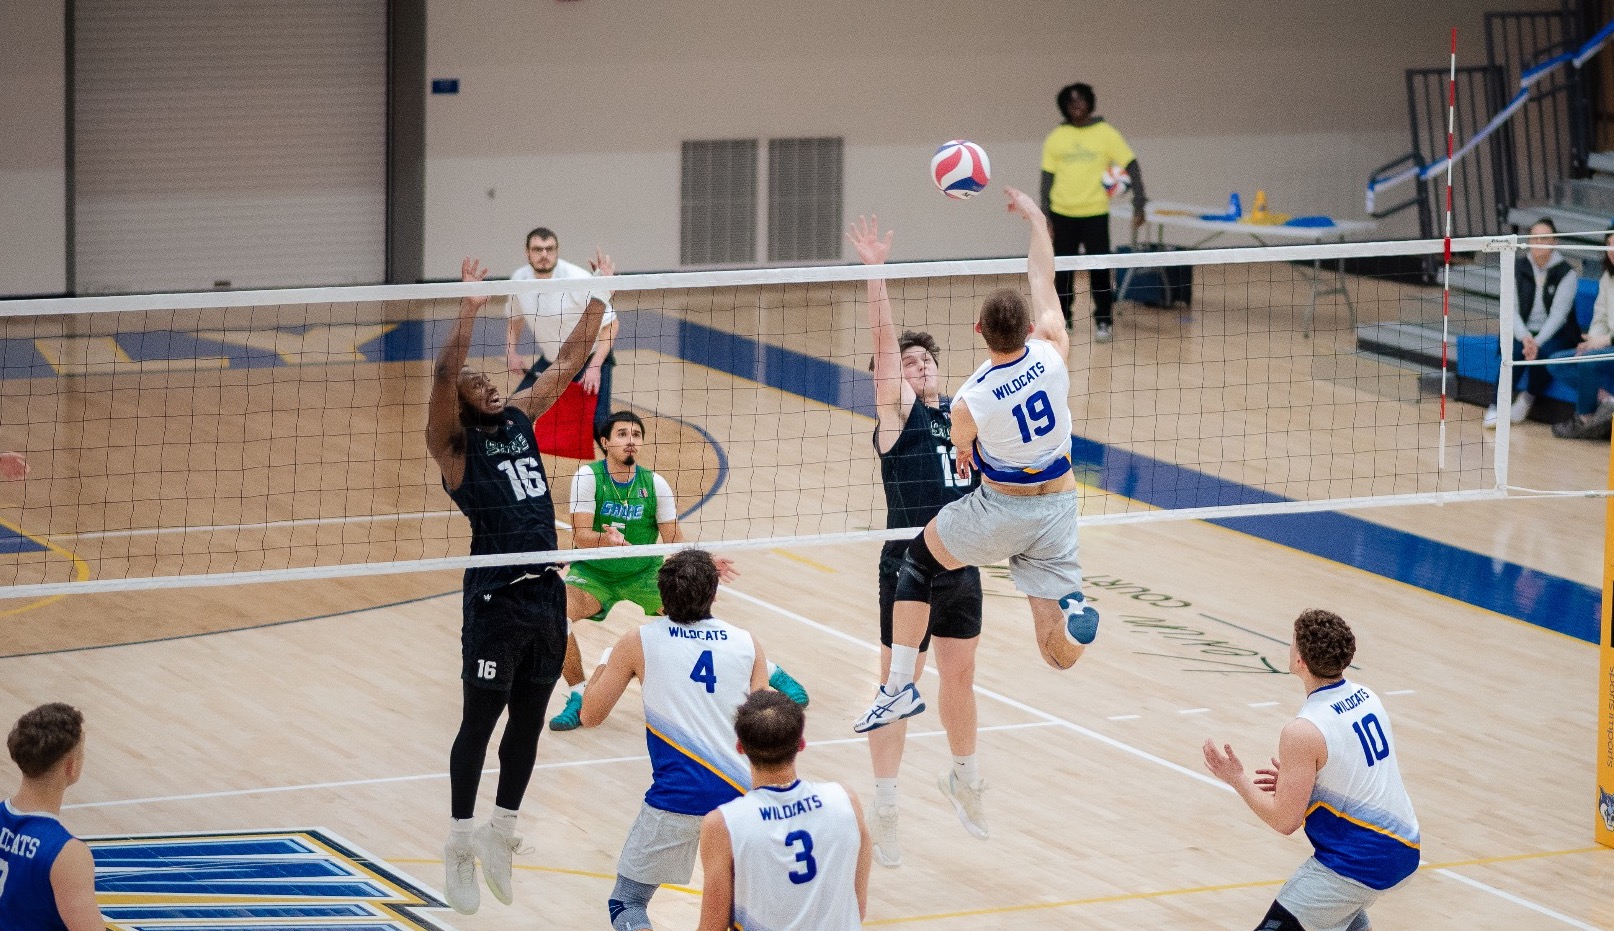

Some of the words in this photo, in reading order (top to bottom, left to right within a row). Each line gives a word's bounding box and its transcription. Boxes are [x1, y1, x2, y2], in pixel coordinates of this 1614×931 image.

[992, 361, 1046, 401] WILDCATS
[1012, 390, 1057, 444] 19
[497, 456, 547, 501] 16
[668, 626, 728, 641] WILDCATS
[477, 659, 497, 680] 16
[689, 650, 717, 693] 4
[1330, 688, 1370, 715] WILDCATS
[1352, 713, 1390, 768] 10
[759, 794, 823, 821] WILDCATS
[785, 829, 817, 885] 3
